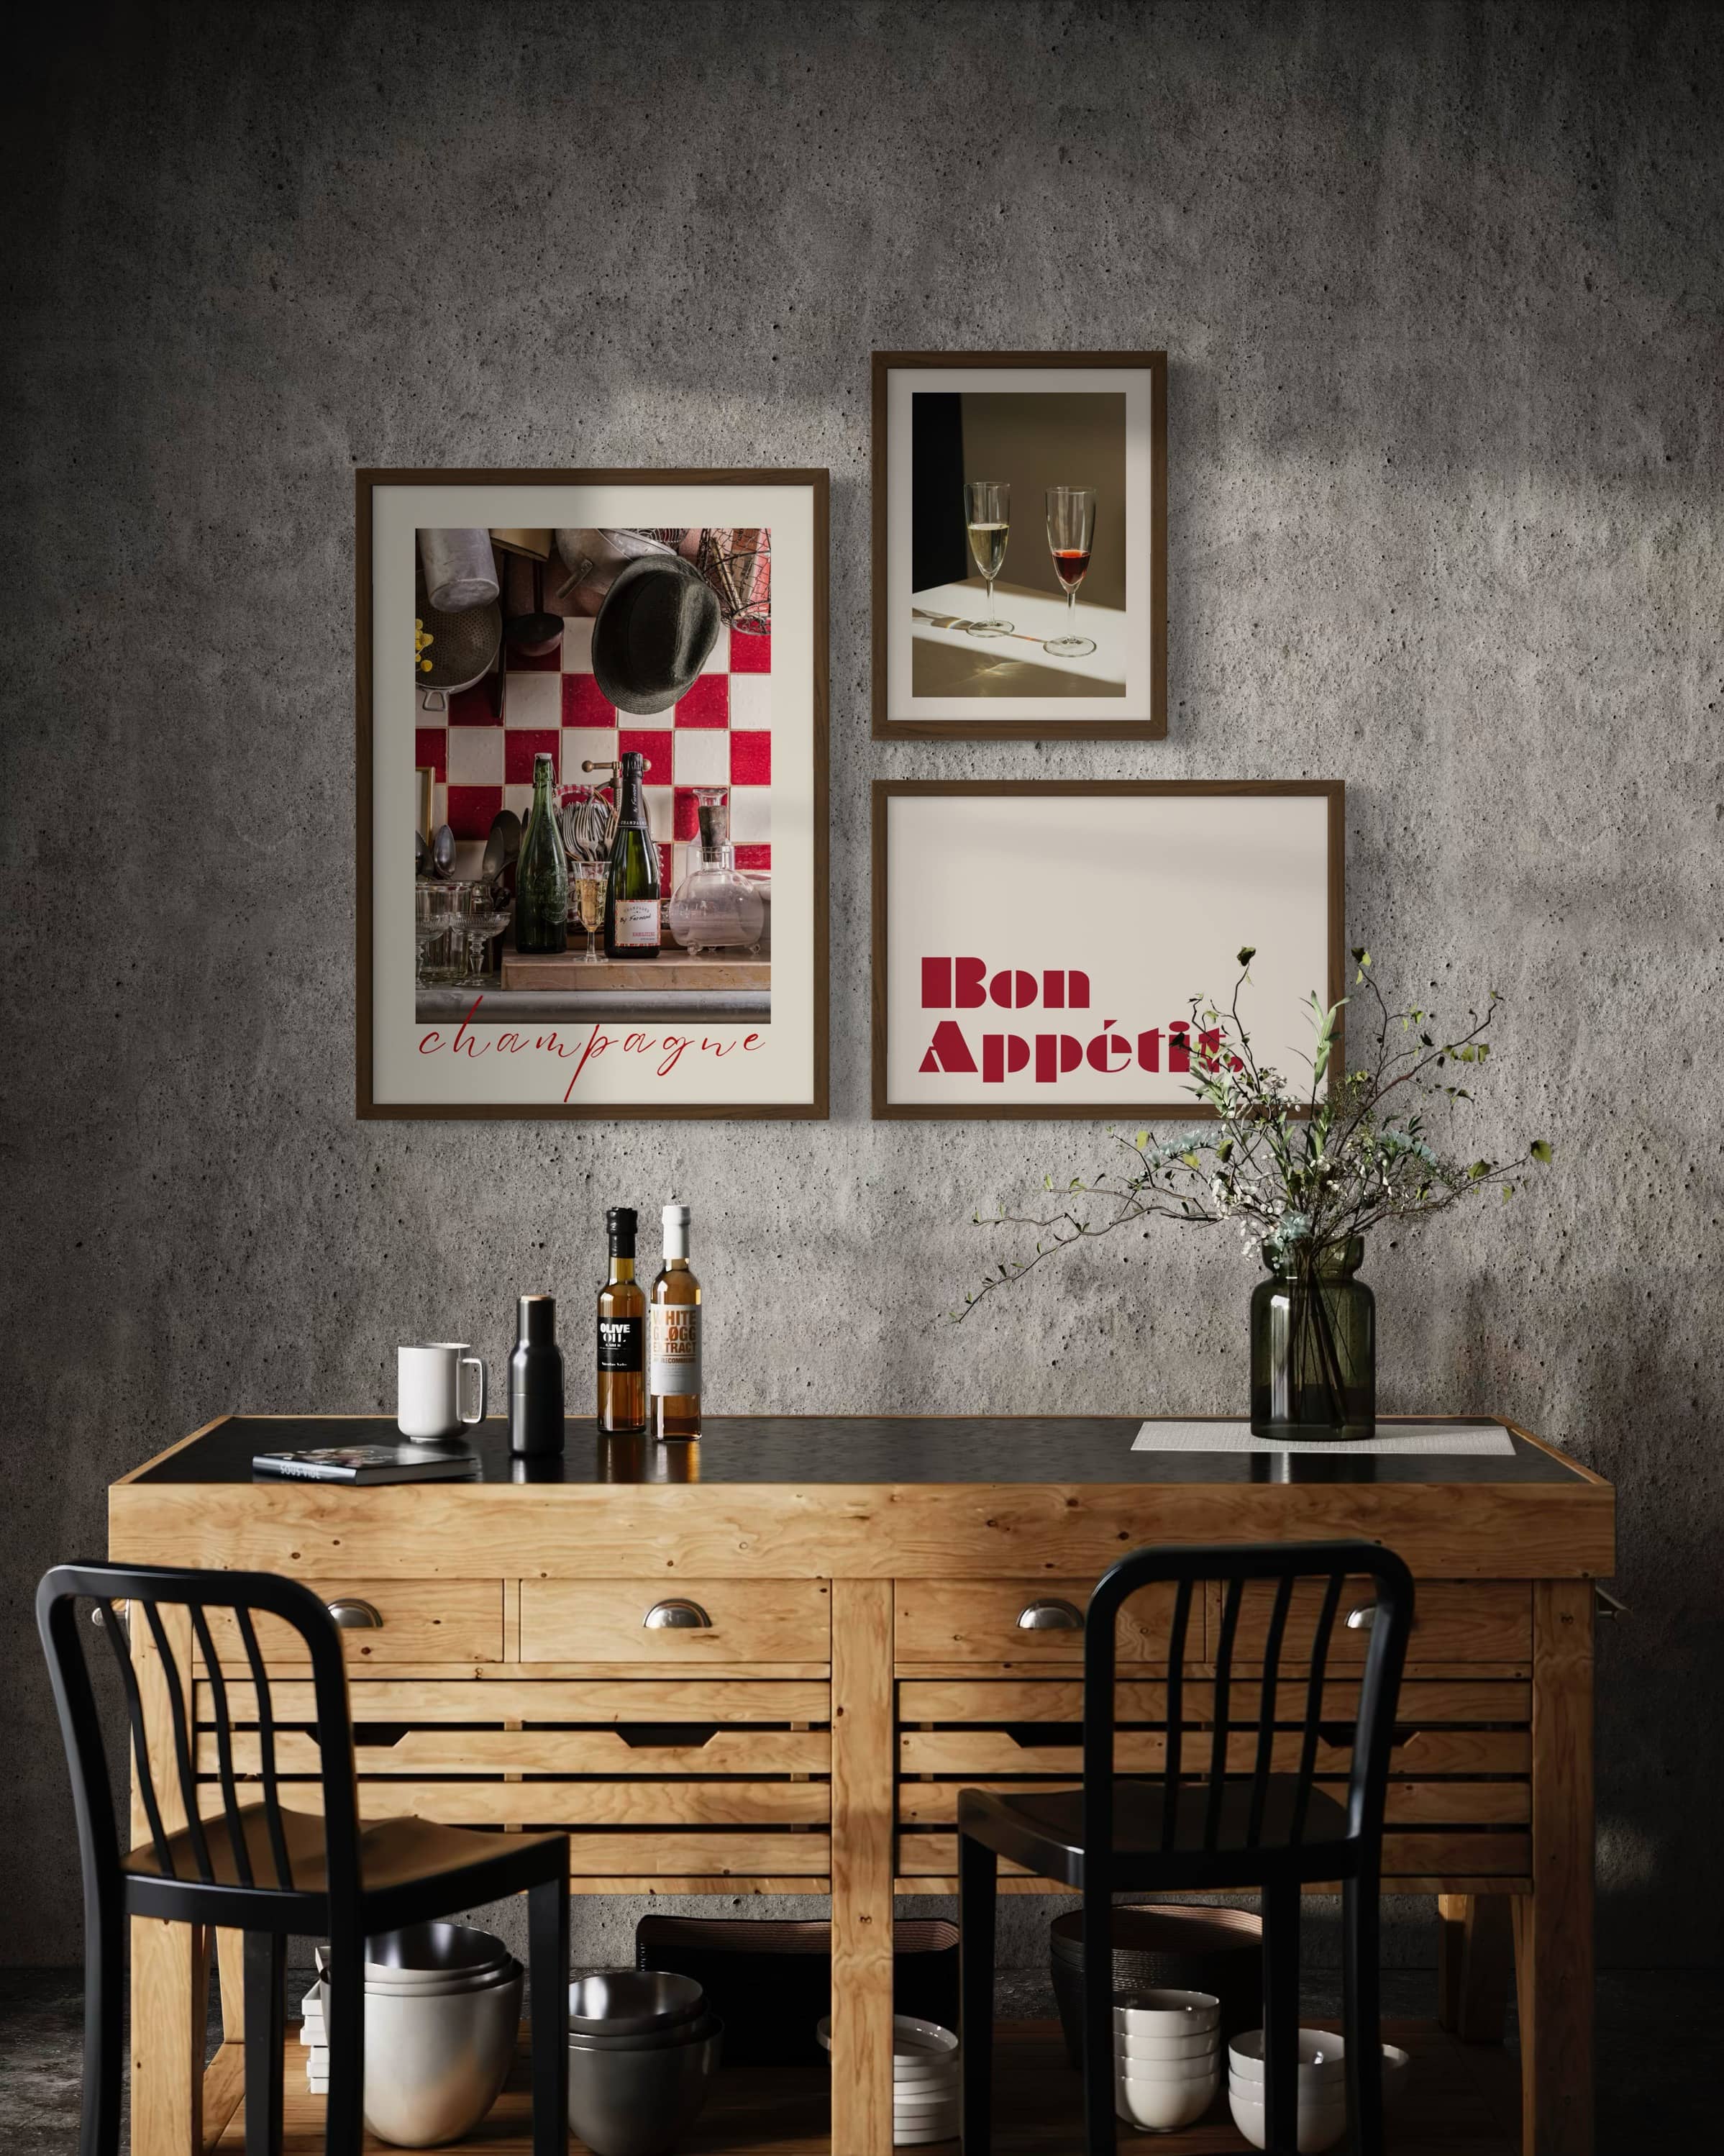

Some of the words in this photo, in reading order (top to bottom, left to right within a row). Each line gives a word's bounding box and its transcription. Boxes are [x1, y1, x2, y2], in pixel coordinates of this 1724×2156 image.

[922, 957, 1090, 1009] Bon
[419, 996, 765, 1102] champagne
[600, 1323, 630, 1333] OLIVE
